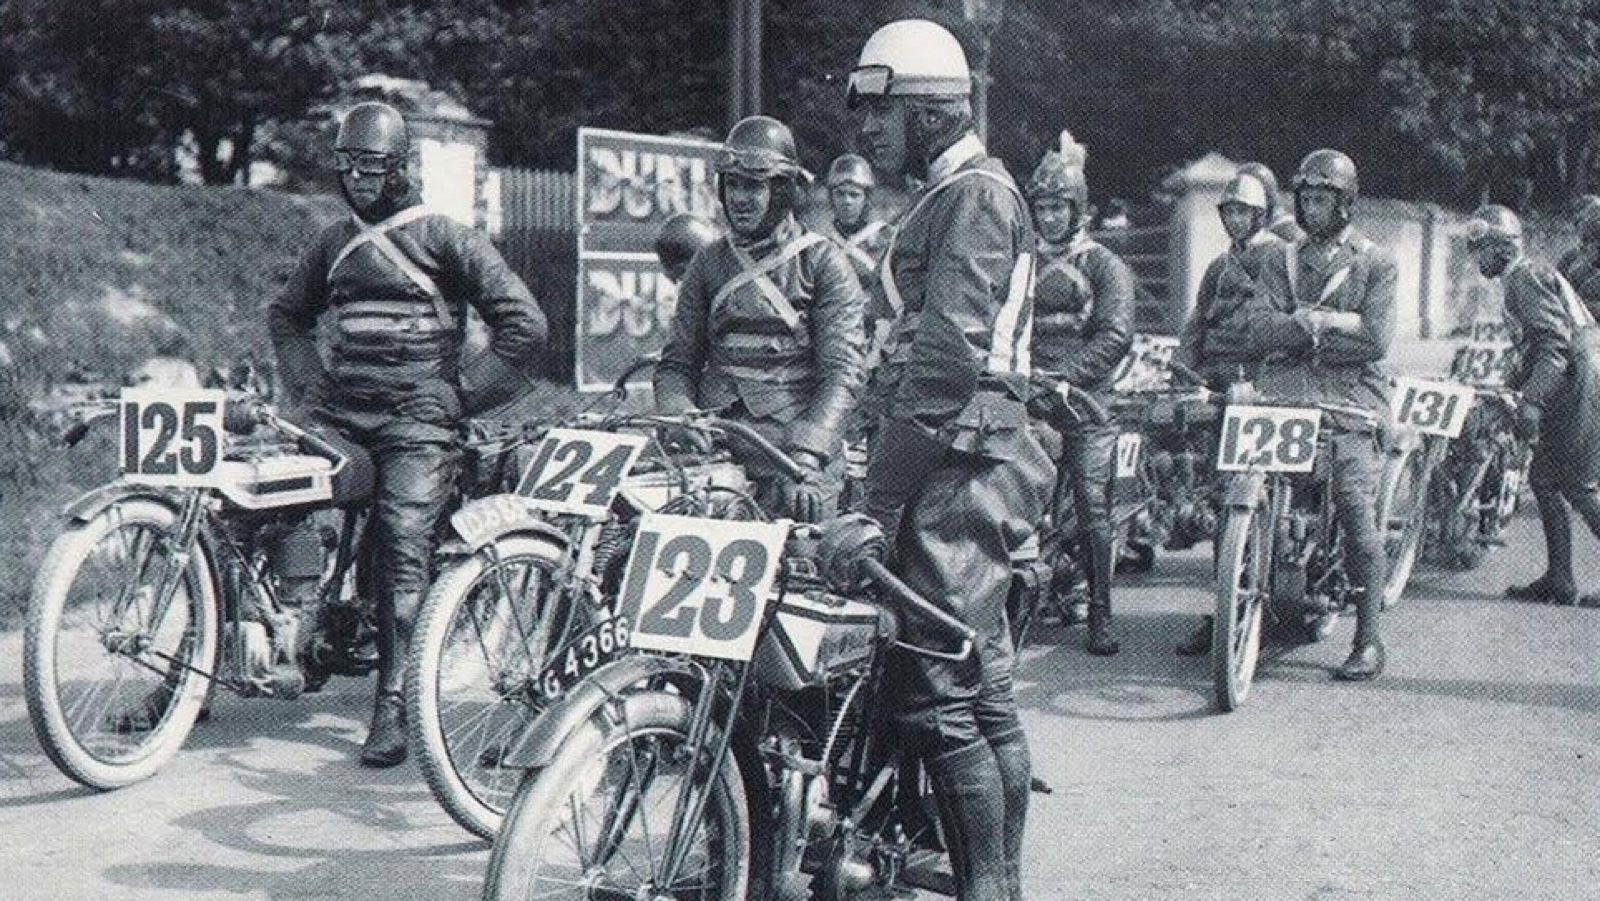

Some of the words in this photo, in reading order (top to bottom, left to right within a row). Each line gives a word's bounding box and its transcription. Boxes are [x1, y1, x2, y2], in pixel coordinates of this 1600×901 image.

[124, 401, 217, 474] 125
[1222, 416, 1316, 466] 128
[1398, 387, 1460, 430] 131
[516, 437, 637, 506] 124
[616, 530, 769, 642] 123
